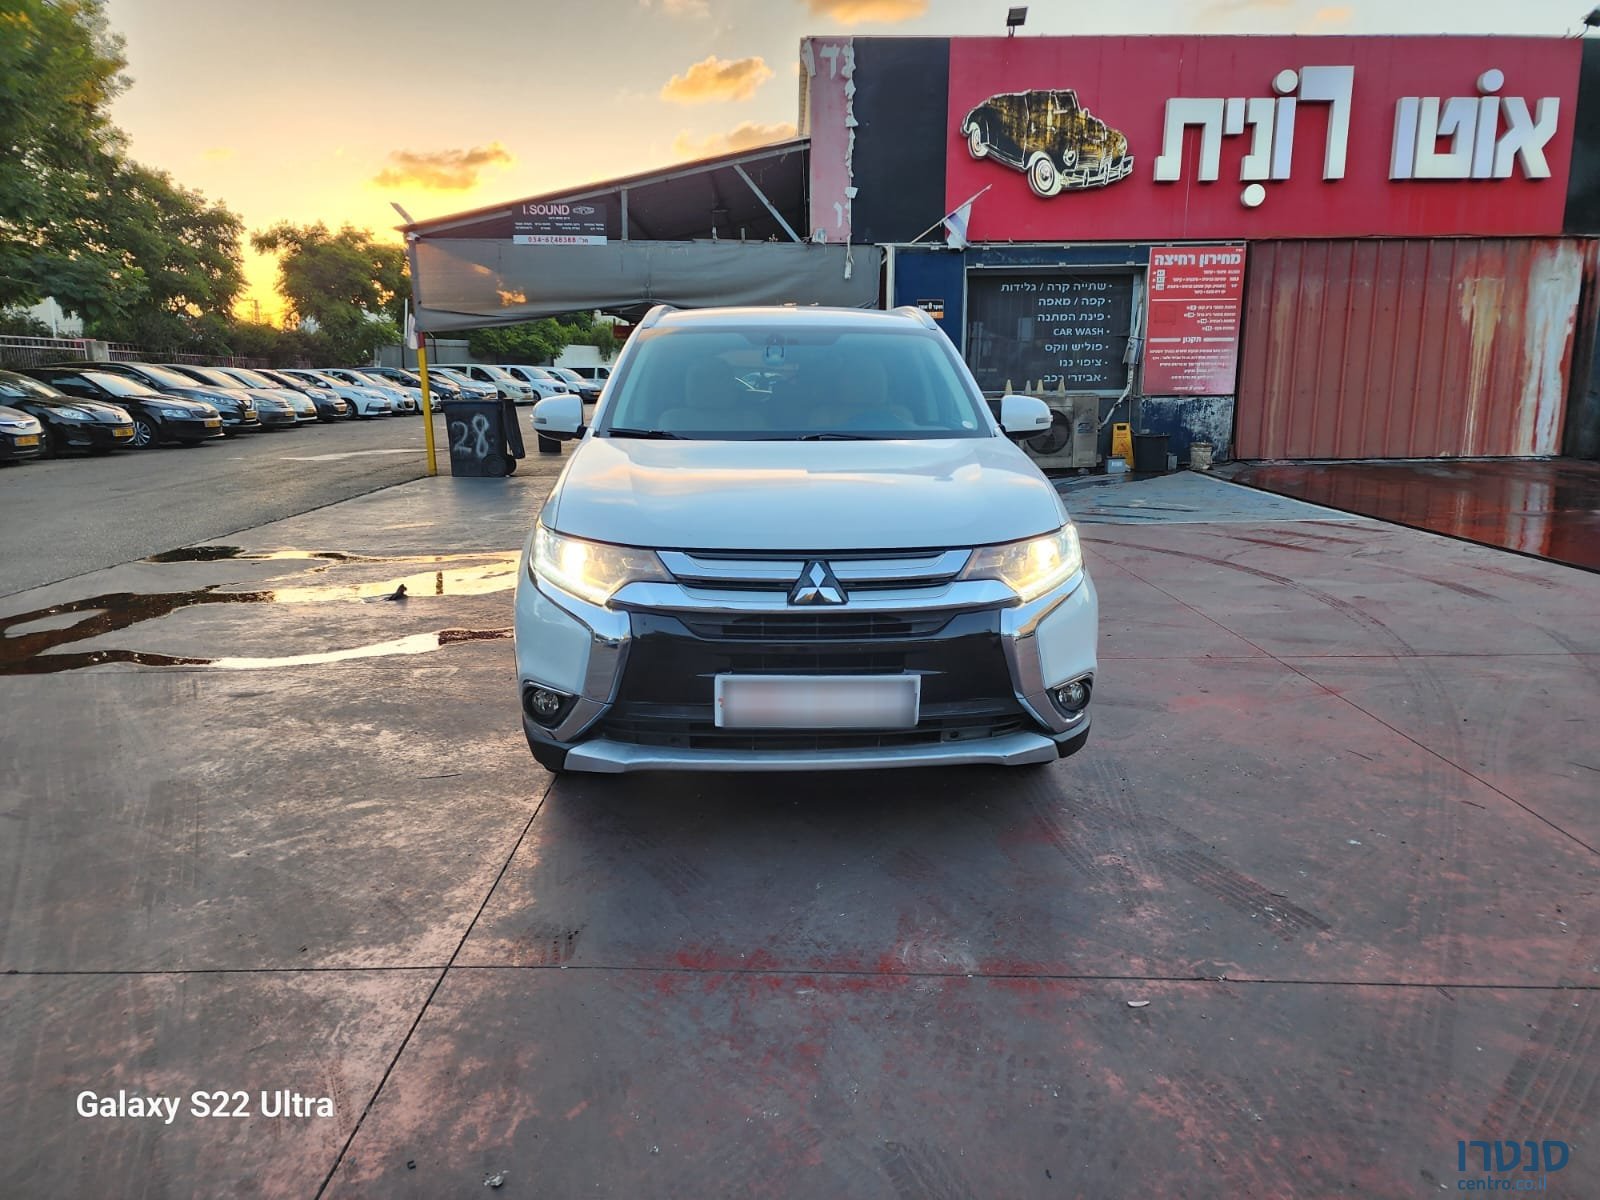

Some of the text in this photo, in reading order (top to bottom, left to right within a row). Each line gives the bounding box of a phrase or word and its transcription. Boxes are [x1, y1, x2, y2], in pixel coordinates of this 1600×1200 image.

[1154, 254, 1241, 267] מחירון רחיצה
[1000, 282, 1036, 292] גלידות
[1047, 283, 1070, 293] קרה
[1073, 282, 1107, 291] שתייה
[1038, 298, 1070, 306] מאפה
[1082, 297, 1106, 307] קפה
[1038, 312, 1104, 321] פינת המתנה
[1054, 328, 1104, 336] CAR WASH
[1044, 342, 1103, 353] פוליש ווקס
[1060, 358, 1102, 366] ציפוי ננו
[1044, 374, 1101, 382] אביזרי רכב
[452, 414, 489, 458] 28
